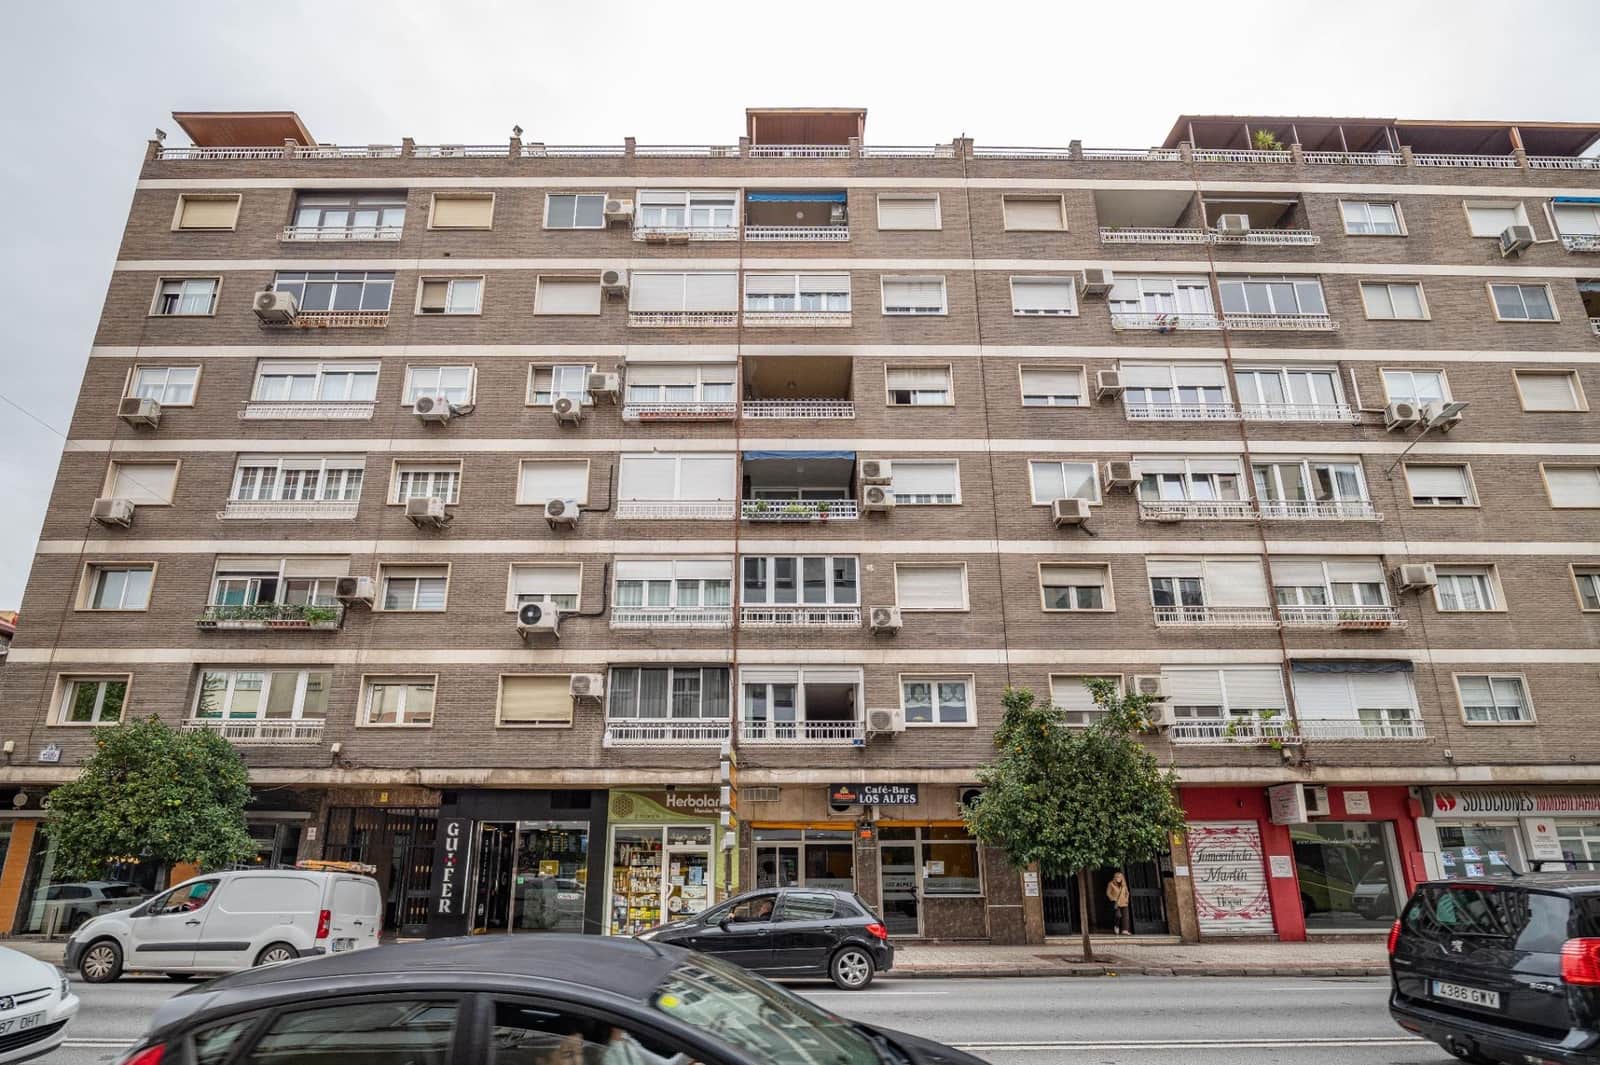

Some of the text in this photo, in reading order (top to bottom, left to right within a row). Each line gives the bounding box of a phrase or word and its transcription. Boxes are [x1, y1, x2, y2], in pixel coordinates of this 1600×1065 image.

[864, 785, 910, 794] Café-Bar
[666, 794, 720, 807] Herbolar
[859, 794, 879, 804] LOS
[882, 794, 917, 804] ALPES
[1462, 791, 1534, 812] SOLUCIONES
[1440, 984, 1496, 1005] 4386 GWV
